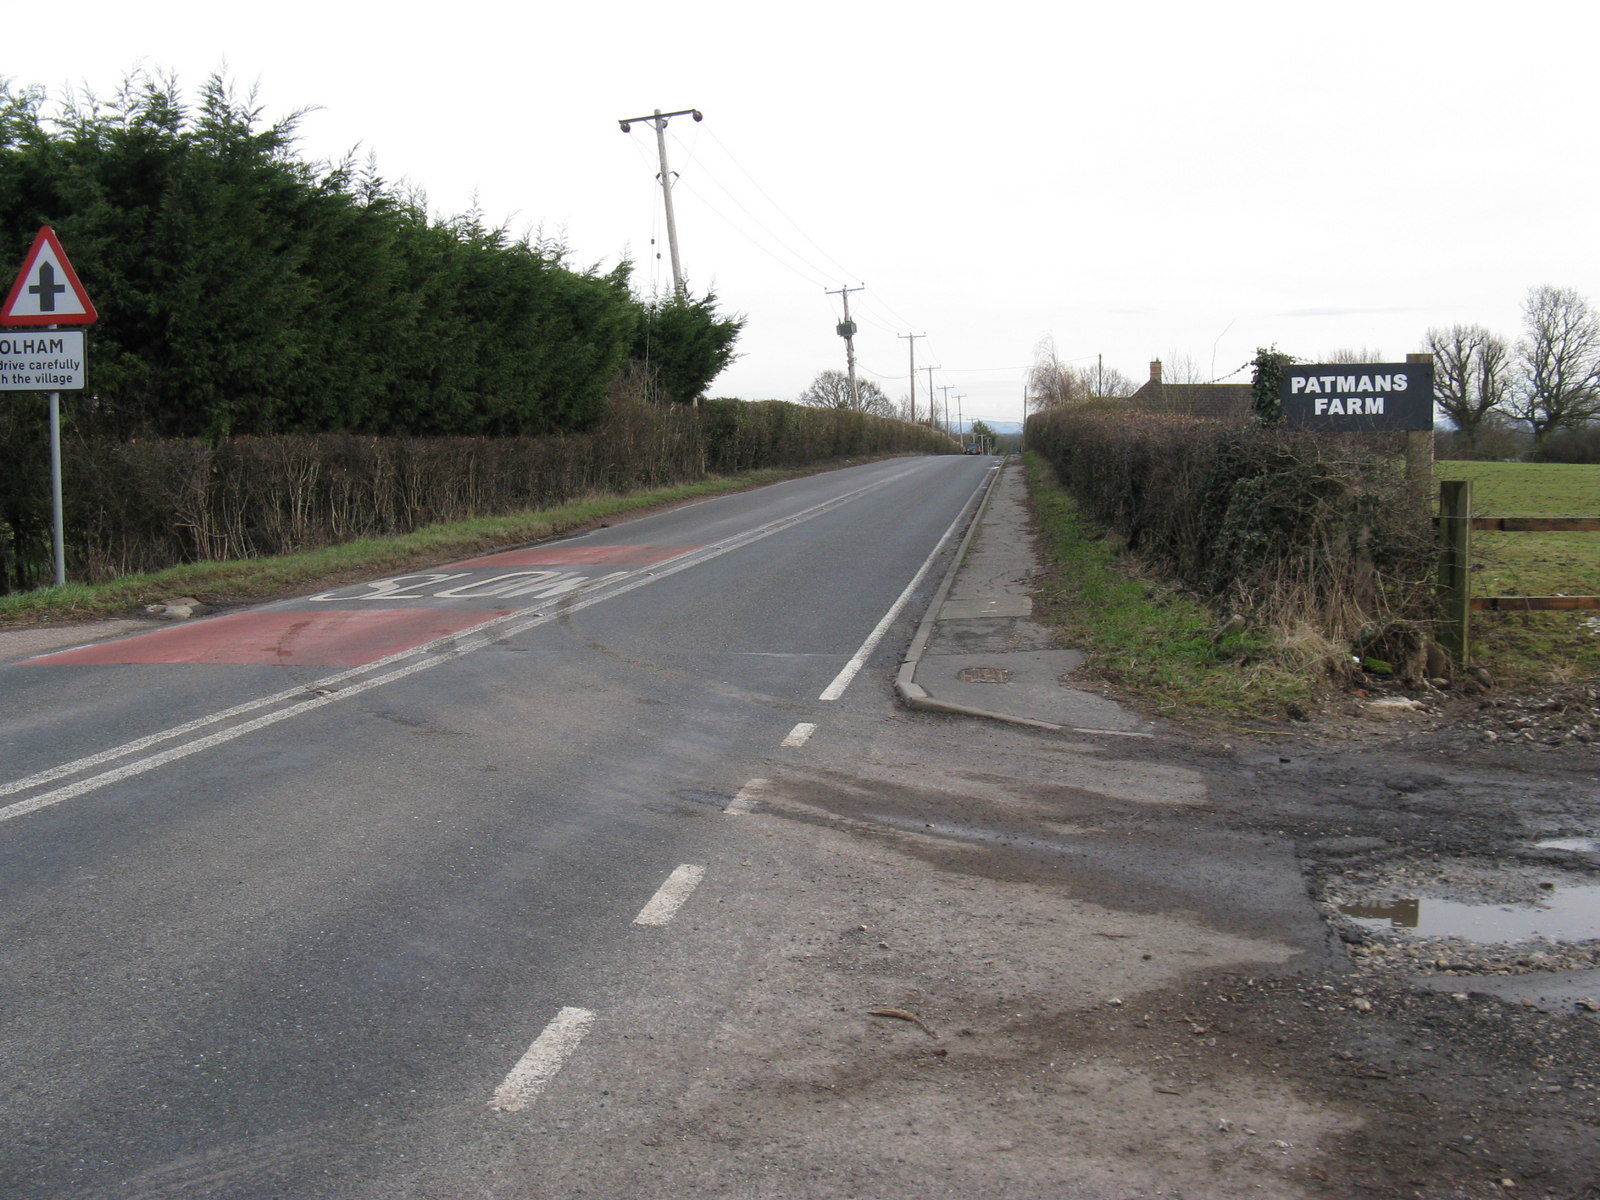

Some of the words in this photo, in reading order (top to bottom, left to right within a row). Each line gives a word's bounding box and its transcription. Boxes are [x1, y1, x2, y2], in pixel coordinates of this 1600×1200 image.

[29, 359, 80, 371] carefully
[12, 373, 31, 384] the
[35, 373, 73, 385] village
[1291, 374, 1408, 394] PATMANS
[1314, 397, 1384, 415] FARM
[308, 570, 628, 601] SLOW
